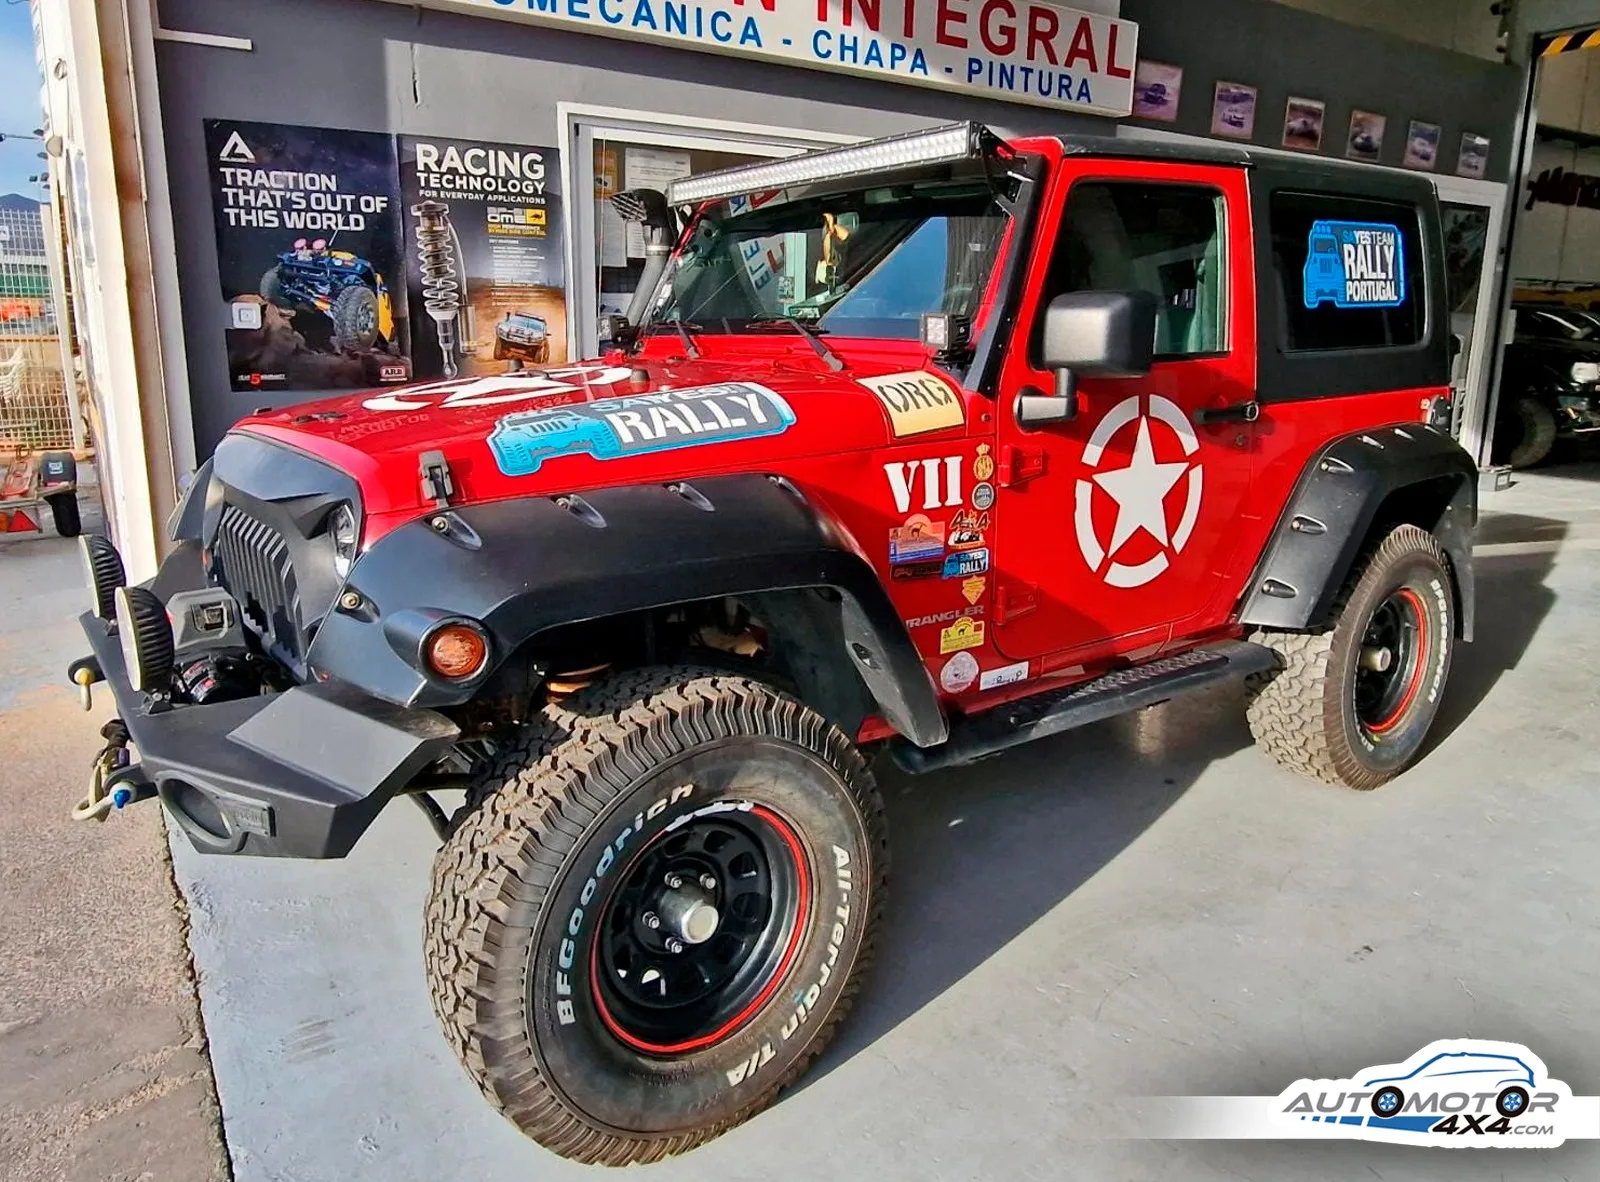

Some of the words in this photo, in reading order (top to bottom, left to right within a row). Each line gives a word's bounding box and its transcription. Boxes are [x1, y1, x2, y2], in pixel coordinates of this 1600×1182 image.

[490, 0, 763, 48] ECANICA
[812, 29, 928, 76] CHAPA
[967, 57, 1093, 104] PINTURA
[416, 143, 545, 180] RACING
[219, 167, 337, 191] TRACTION
[416, 172, 546, 195] TECHNOLOGY
[221, 188, 306, 210] THAT'S
[310, 192, 355, 212] OUT
[359, 195, 388, 213] OF
[420, 189, 438, 198] FOR
[440, 190, 485, 201] EVERYDAY
[487, 194, 546, 205] APPLICATIONS
[223, 208, 279, 228] THIS
[282, 210, 365, 231] WORLD
[1343, 243, 1395, 280] RALLY
[1346, 280, 1398, 302] PORTUGAL
[604, 393, 768, 444] RALLY
[883, 455, 963, 514] VII
[960, 559, 987, 575] RALLY
[906, 605, 985, 628] RANGLER
[780, 844, 852, 1042] All-Terrain
